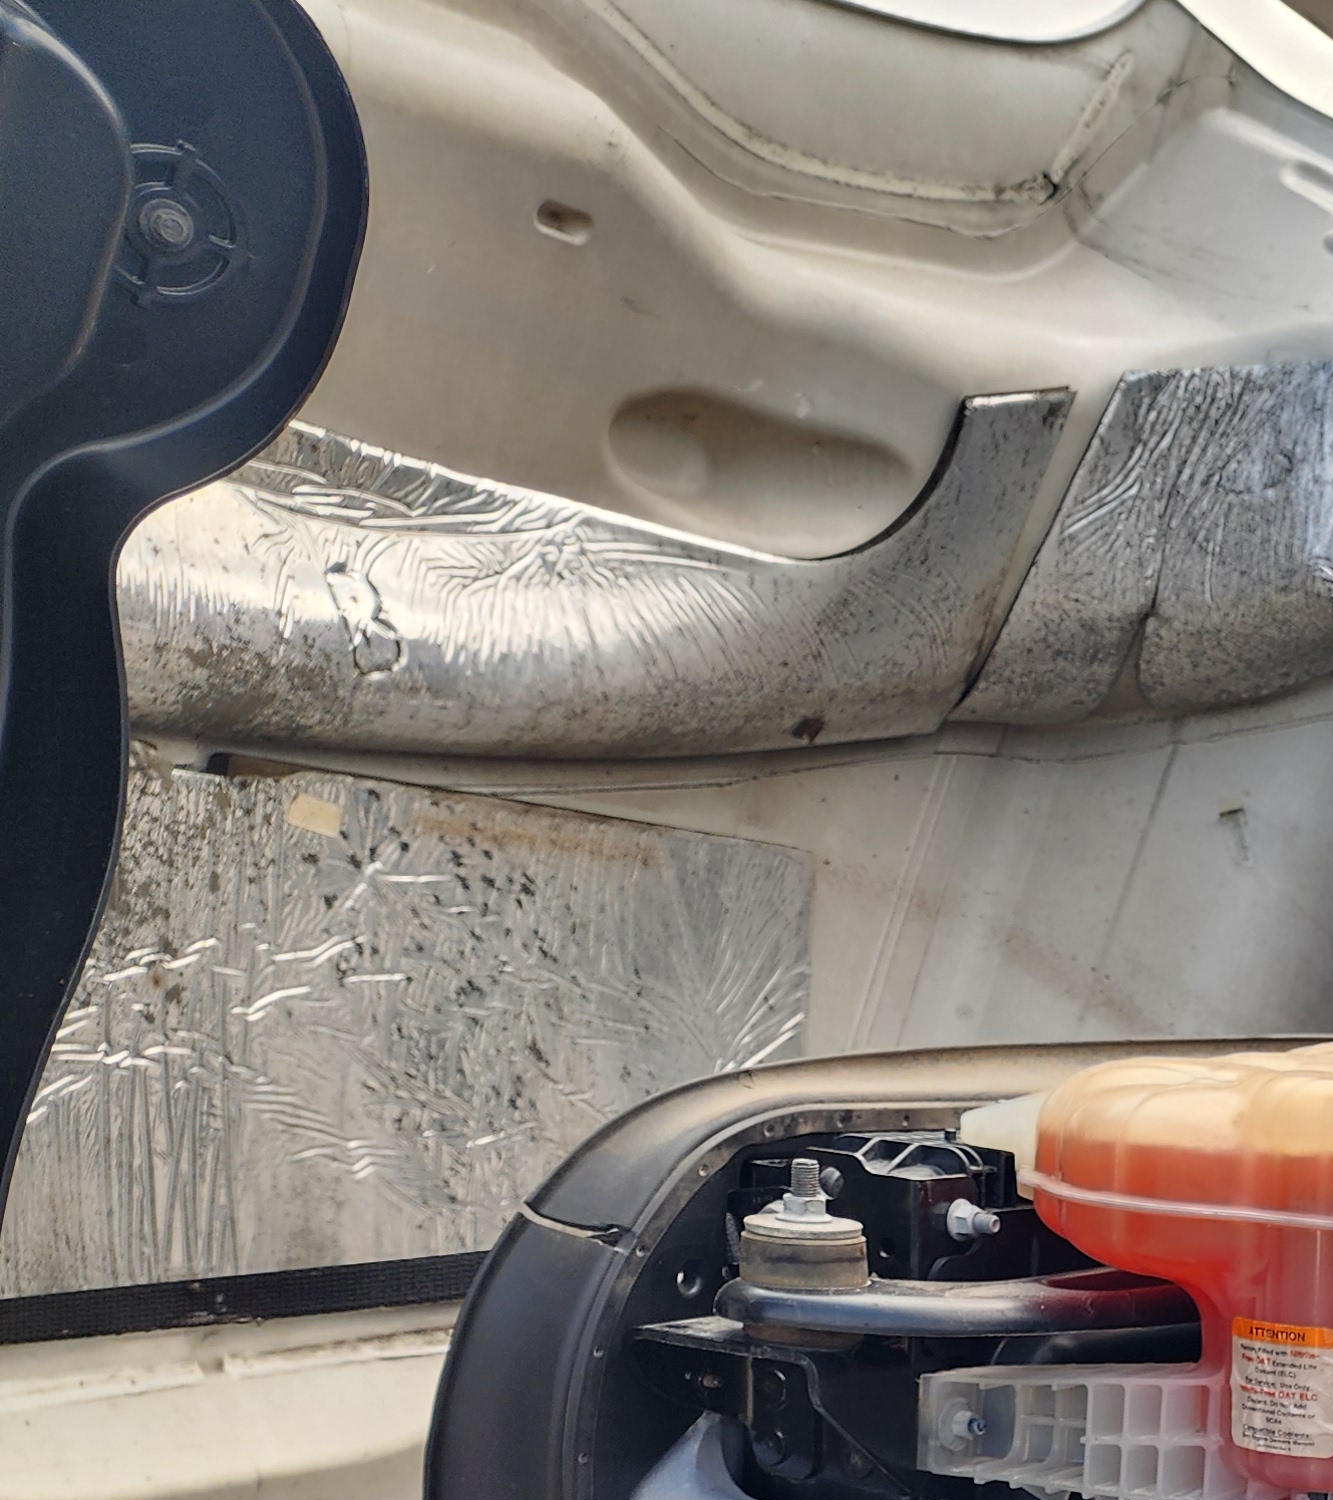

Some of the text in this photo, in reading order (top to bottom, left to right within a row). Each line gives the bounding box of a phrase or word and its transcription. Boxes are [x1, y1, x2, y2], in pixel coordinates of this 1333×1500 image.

[1248, 1325, 1306, 1343] ATTENTION
[1277, 1390, 1297, 1400] OAT
[1299, 1392, 1318, 1402] ELC
